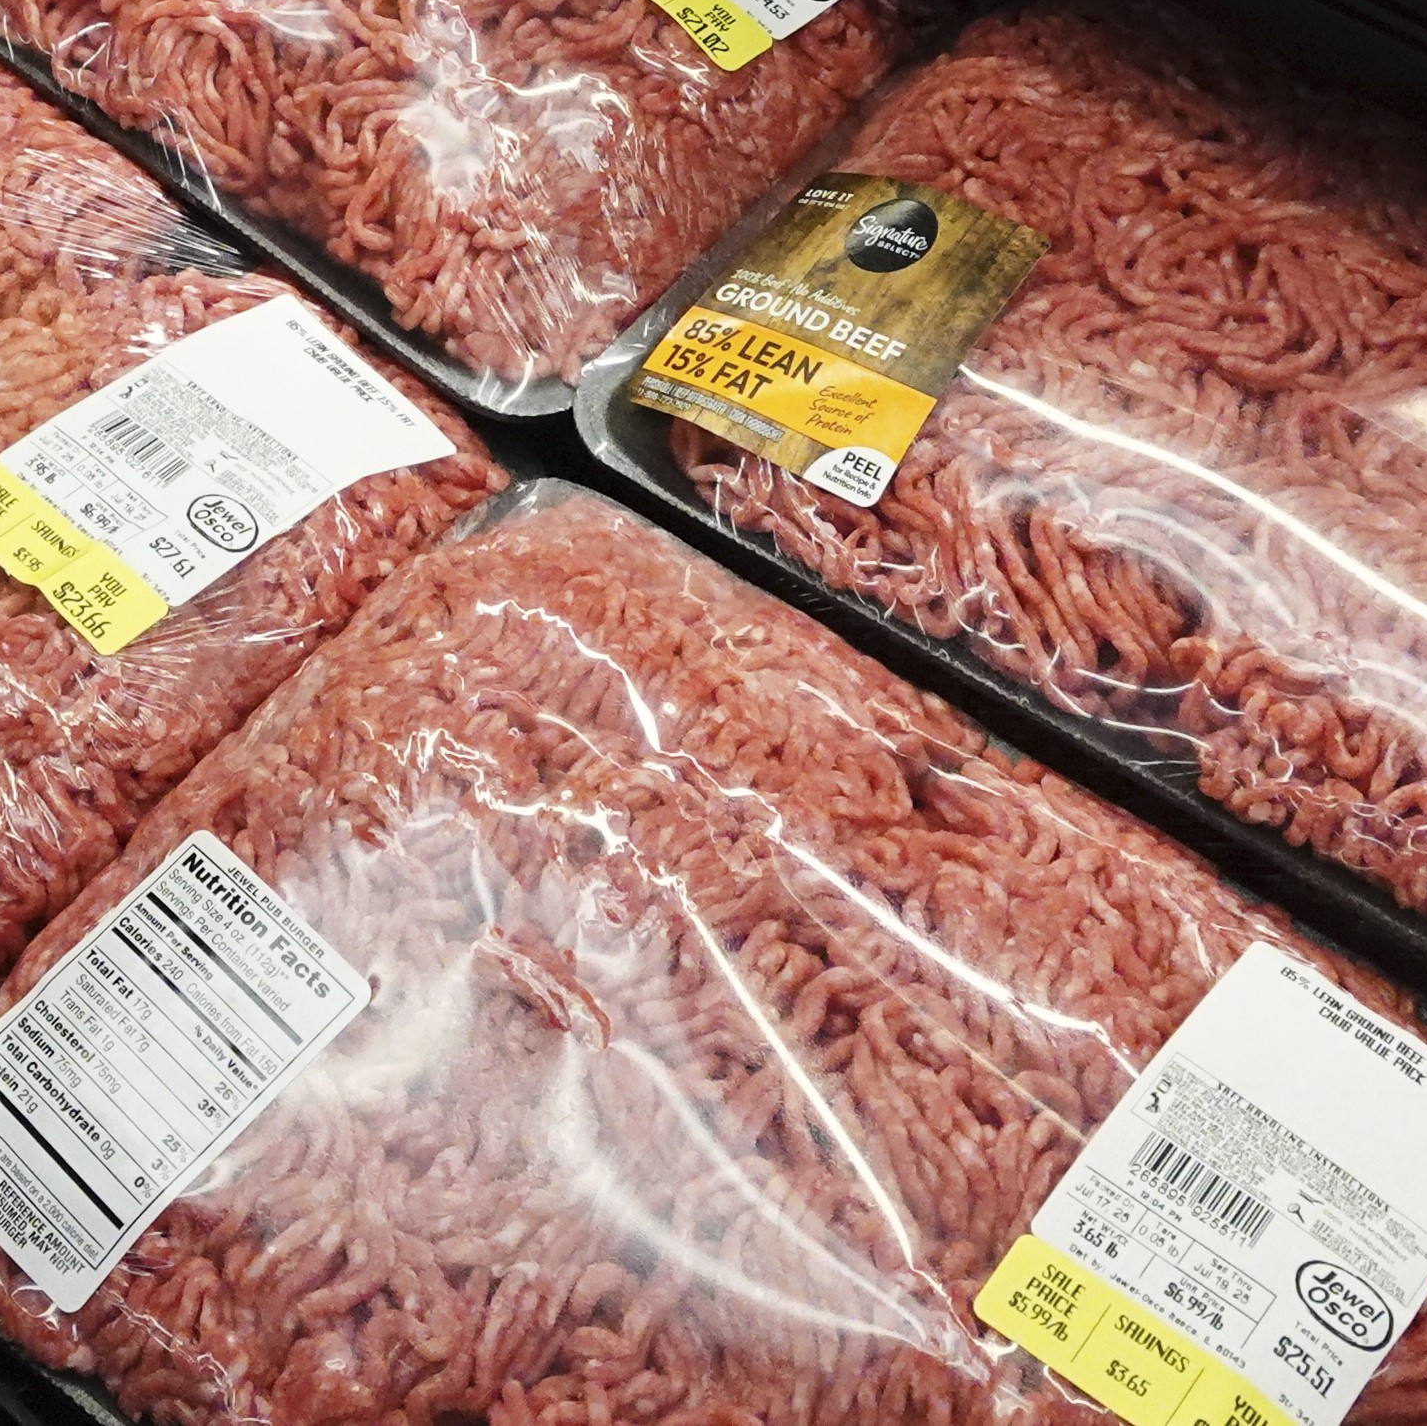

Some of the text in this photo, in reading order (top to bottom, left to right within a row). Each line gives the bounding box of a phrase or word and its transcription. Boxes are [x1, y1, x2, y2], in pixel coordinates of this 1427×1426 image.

[677, 7, 730, 59] $21.02
[805, 189, 854, 201] LOVE IT
[853, 216, 928, 251] Signature
[731, 269, 861, 316] 100% Beef No Additives
[716, 283, 907, 361] GROUND BEEF
[663, 344, 773, 399] 15% FAT
[684, 319, 823, 385] 85% LEAN
[809, 399, 852, 419] Source
[819, 385, 878, 409] Excellent
[805, 414, 852, 436] Protein
[822, 470, 856, 492] Nutrition
[841, 451, 882, 481] PEEL
[843, 467, 869, 487] Recipe
[31, 520, 79, 559] SAVINGS
[194, 510, 234, 543] Osco
[202, 497, 251, 537] Jewel
[13, 547, 45, 572] $3.95
[148, 536, 196, 581] $27.61
[52, 581, 113, 640] $23.66
[181, 852, 331, 999] Nutrition Facts
[227, 866, 325, 959] JEWEL PUB BURGER
[119, 916, 184, 981] Calories 240
[156, 881, 291, 1012] Servings Per Container varied
[85, 950, 134, 1000] Total Fat
[17, 1017, 55, 1058] Sodium
[34, 1000, 96, 1064] Cholesterol
[1280, 966, 1310, 990] 85%
[1313, 986, 1343, 1012] LEAN
[1346, 1009, 1395, 1045] GROUND
[1396, 1041, 1426, 1066] BEEF
[1318, 1006, 1427, 1086] CHUB VALUE PACK
[0, 1035, 100, 1142] Total Carbohydrate
[1026, 1276, 1078, 1320] PRICE
[1042, 1264, 1086, 1302] SALE
[1312, 1271, 1385, 1323] Jewel
[1008, 1290, 1069, 1343] $5.99/lb
[1308, 1287, 1367, 1337] Osco
[1114, 1314, 1190, 1374] SAVINGS
[1273, 1336, 1335, 1399] $25.51
[1106, 1359, 1152, 1398] $3.65
